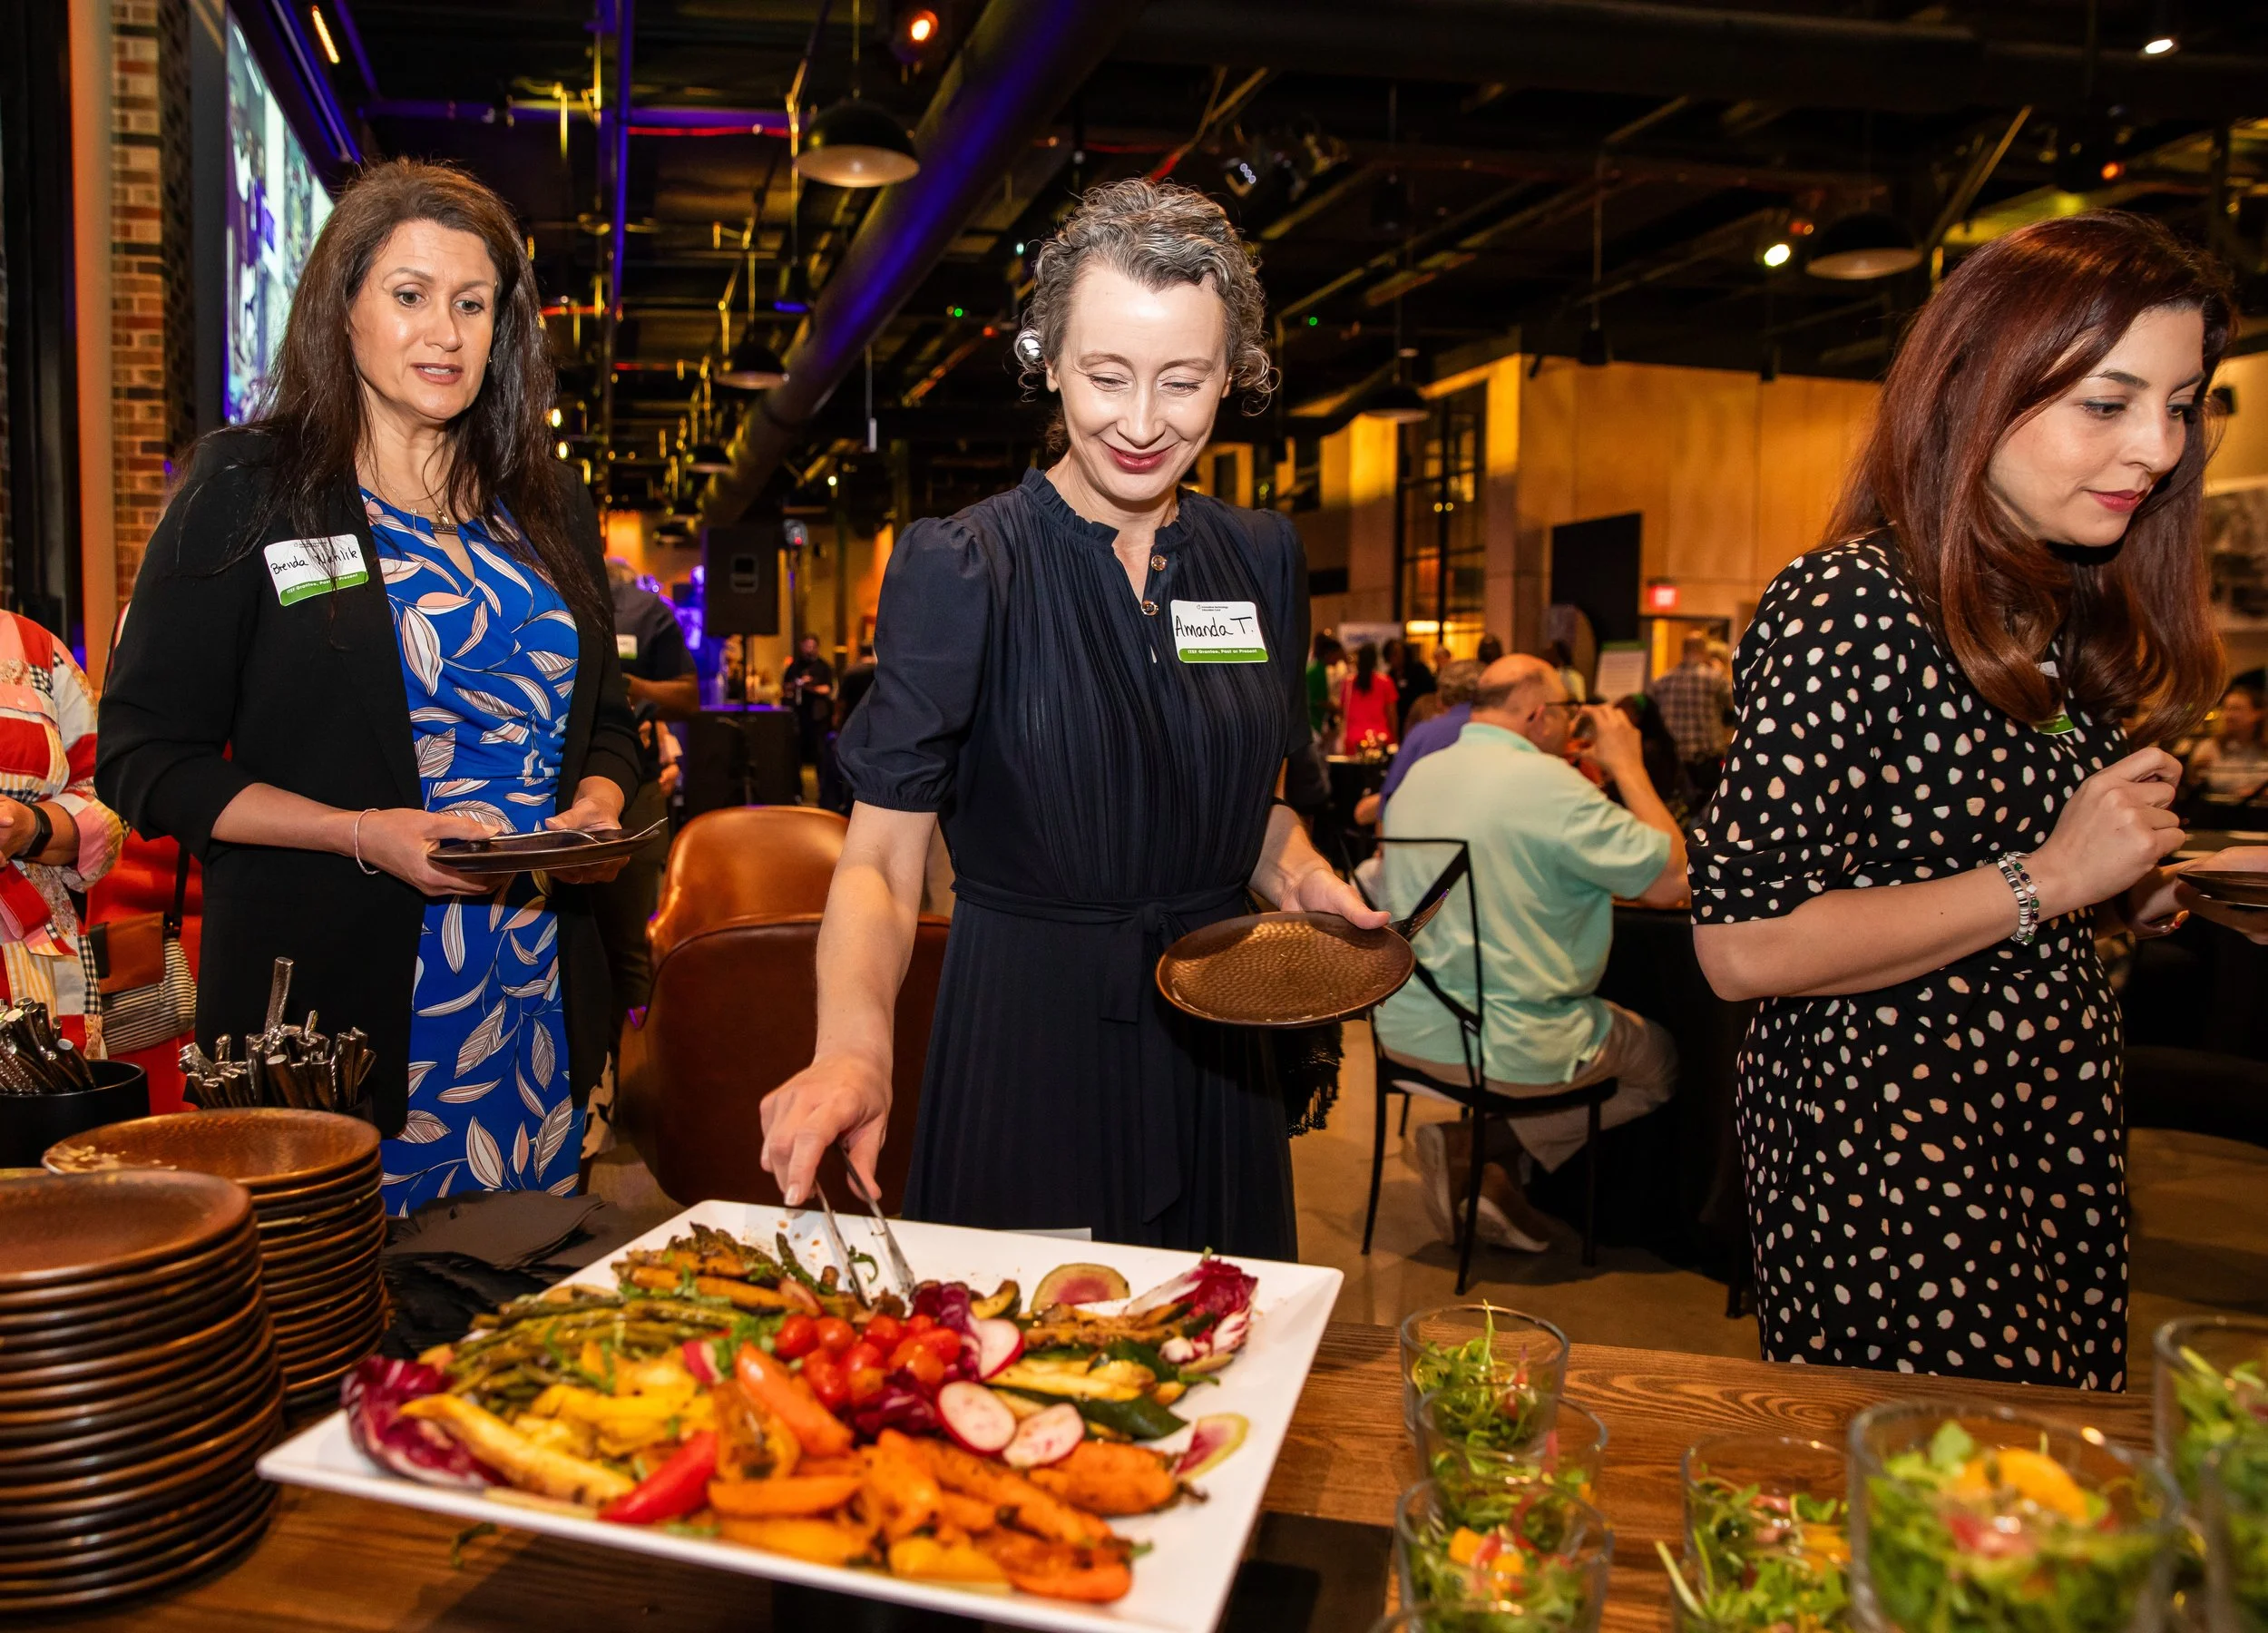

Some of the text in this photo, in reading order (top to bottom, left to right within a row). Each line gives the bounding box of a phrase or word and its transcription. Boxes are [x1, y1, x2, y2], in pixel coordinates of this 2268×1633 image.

[270, 555, 309, 574] Brenda
[296, 582, 319, 591] Grantee,
[1176, 615, 1234, 637] Amanda
